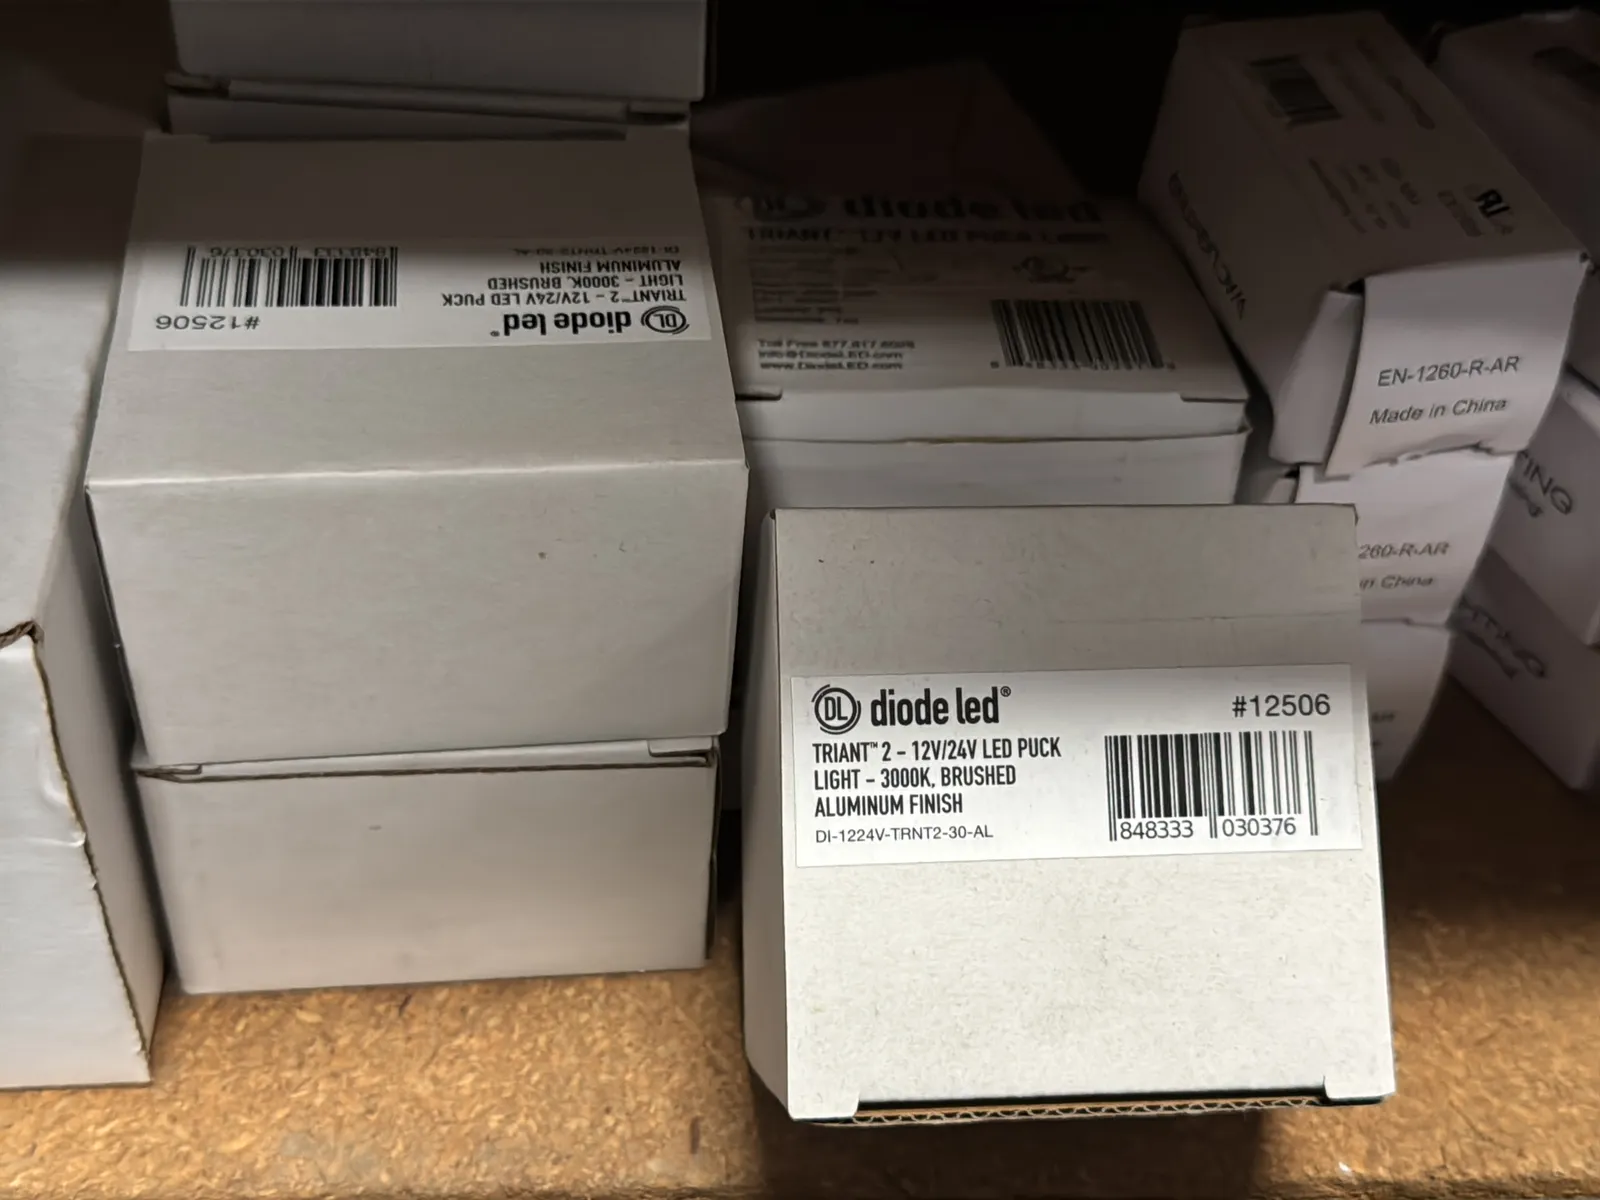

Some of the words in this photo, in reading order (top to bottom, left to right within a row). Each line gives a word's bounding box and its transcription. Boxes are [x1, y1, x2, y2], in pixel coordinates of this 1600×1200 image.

[539, 260, 592, 275] FINISH
[596, 259, 682, 272] ALUMINUM
[487, 276, 562, 291] BRUSHED
[639, 273, 685, 288] LIGHT
[441, 292, 486, 307] PUCK
[490, 292, 521, 306] LED
[525, 290, 591, 305] 12V/24V
[610, 290, 620, 303] 2
[155, 314, 261, 331] #12506
[553, 310, 632, 335] diode
[1376, 355, 1521, 387] EN-1260-R-AR
[1369, 407, 1423, 424] Made
[1429, 404, 1446, 418] in
[1452, 398, 1508, 417] China
[1358, 541, 1450, 560] 260-R-AR
[1380, 575, 1435, 591] China
[869, 687, 950, 727] diode
[1231, 693, 1331, 718] #12506
[881, 741, 892, 762] 2
[911, 739, 978, 761] 12V/24V
[982, 738, 1013, 760] LED
[1017, 736, 1063, 759] PUCK
[813, 768, 861, 791] LIGHT
[880, 767, 936, 789] 3000K,
[940, 764, 1017, 787] BRUSHED
[814, 795, 904, 818] ALUMINUM
[909, 792, 964, 815] FINISH
[815, 824, 995, 844] DI-1224V-TRNT2-30-AL
[1119, 820, 1194, 841] 848333
[1222, 817, 1297, 838] 030376
